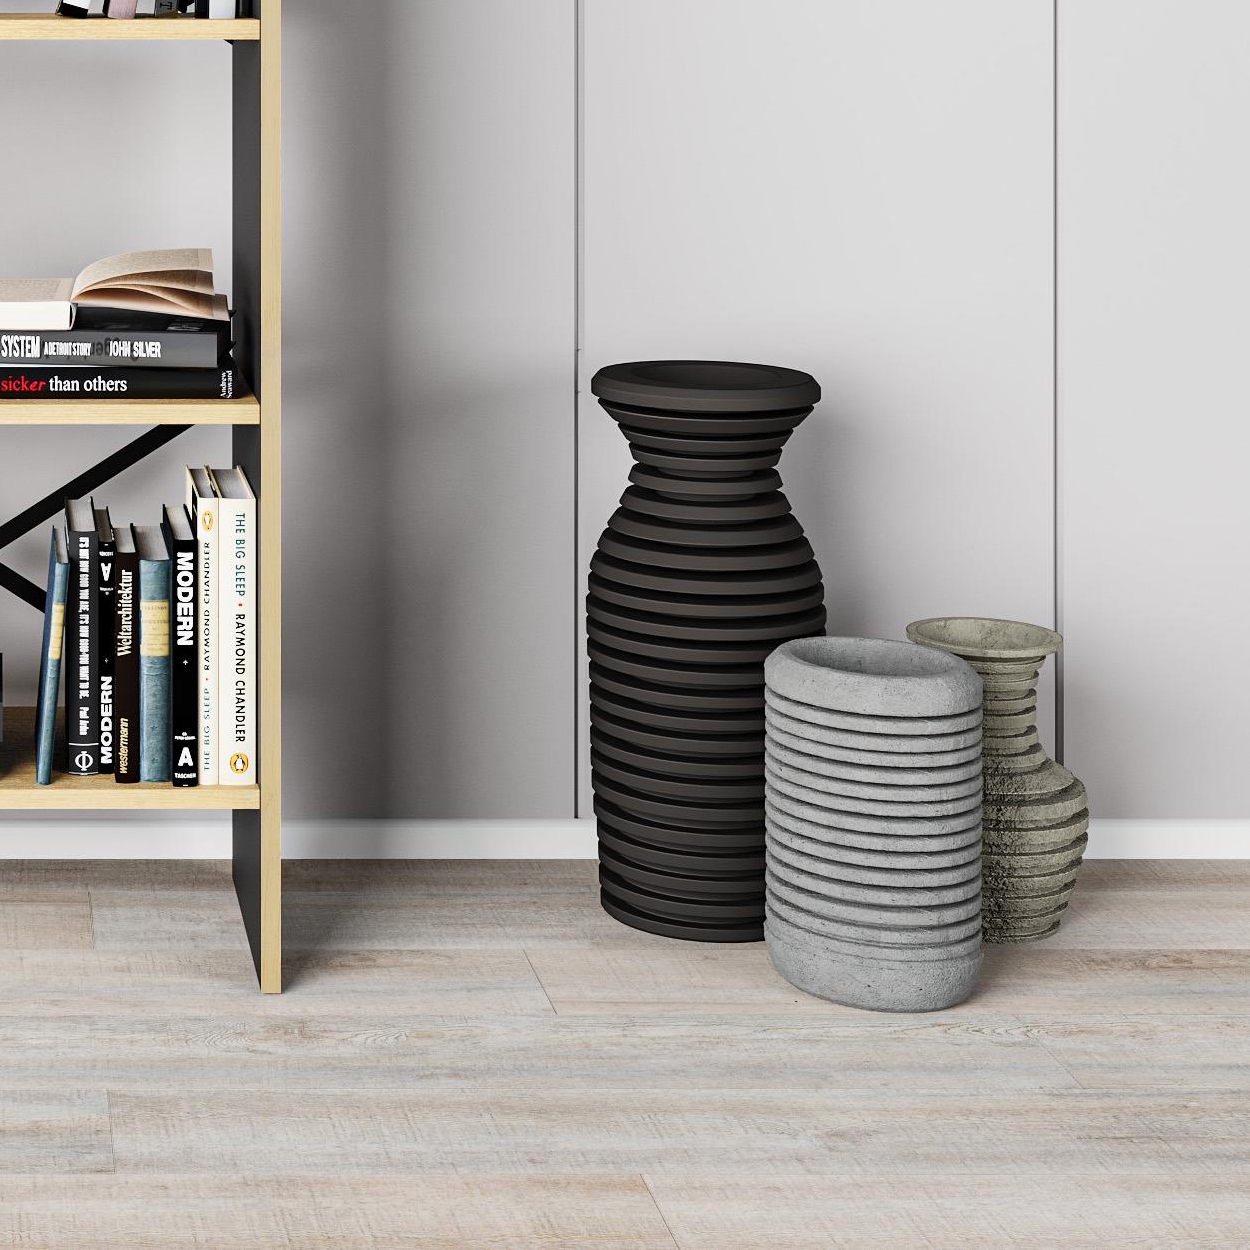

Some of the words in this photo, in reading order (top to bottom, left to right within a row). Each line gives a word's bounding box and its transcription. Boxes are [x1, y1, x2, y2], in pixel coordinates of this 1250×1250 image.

[1, 335, 41, 358] SYSTEM
[109, 340, 131, 357] JOHN
[132, 341, 161, 358] SILVER
[1, 376, 46, 392] sicker
[49, 377, 79, 392] than
[84, 377, 127, 392] others
[235, 513, 245, 533] THE
[235, 540, 245, 558] BIG
[101, 563, 111, 581] A
[235, 565, 245, 596] SLEEP
[117, 570, 133, 657] Weltarchitektur
[176, 552, 193, 645] MODERN
[235, 614, 245, 675] RAYMOND
[101, 676, 112, 764] MODERN
[235, 681, 245, 742] CHANDLER
[118, 717, 129, 774] westermann
[178, 747, 193, 766] A
